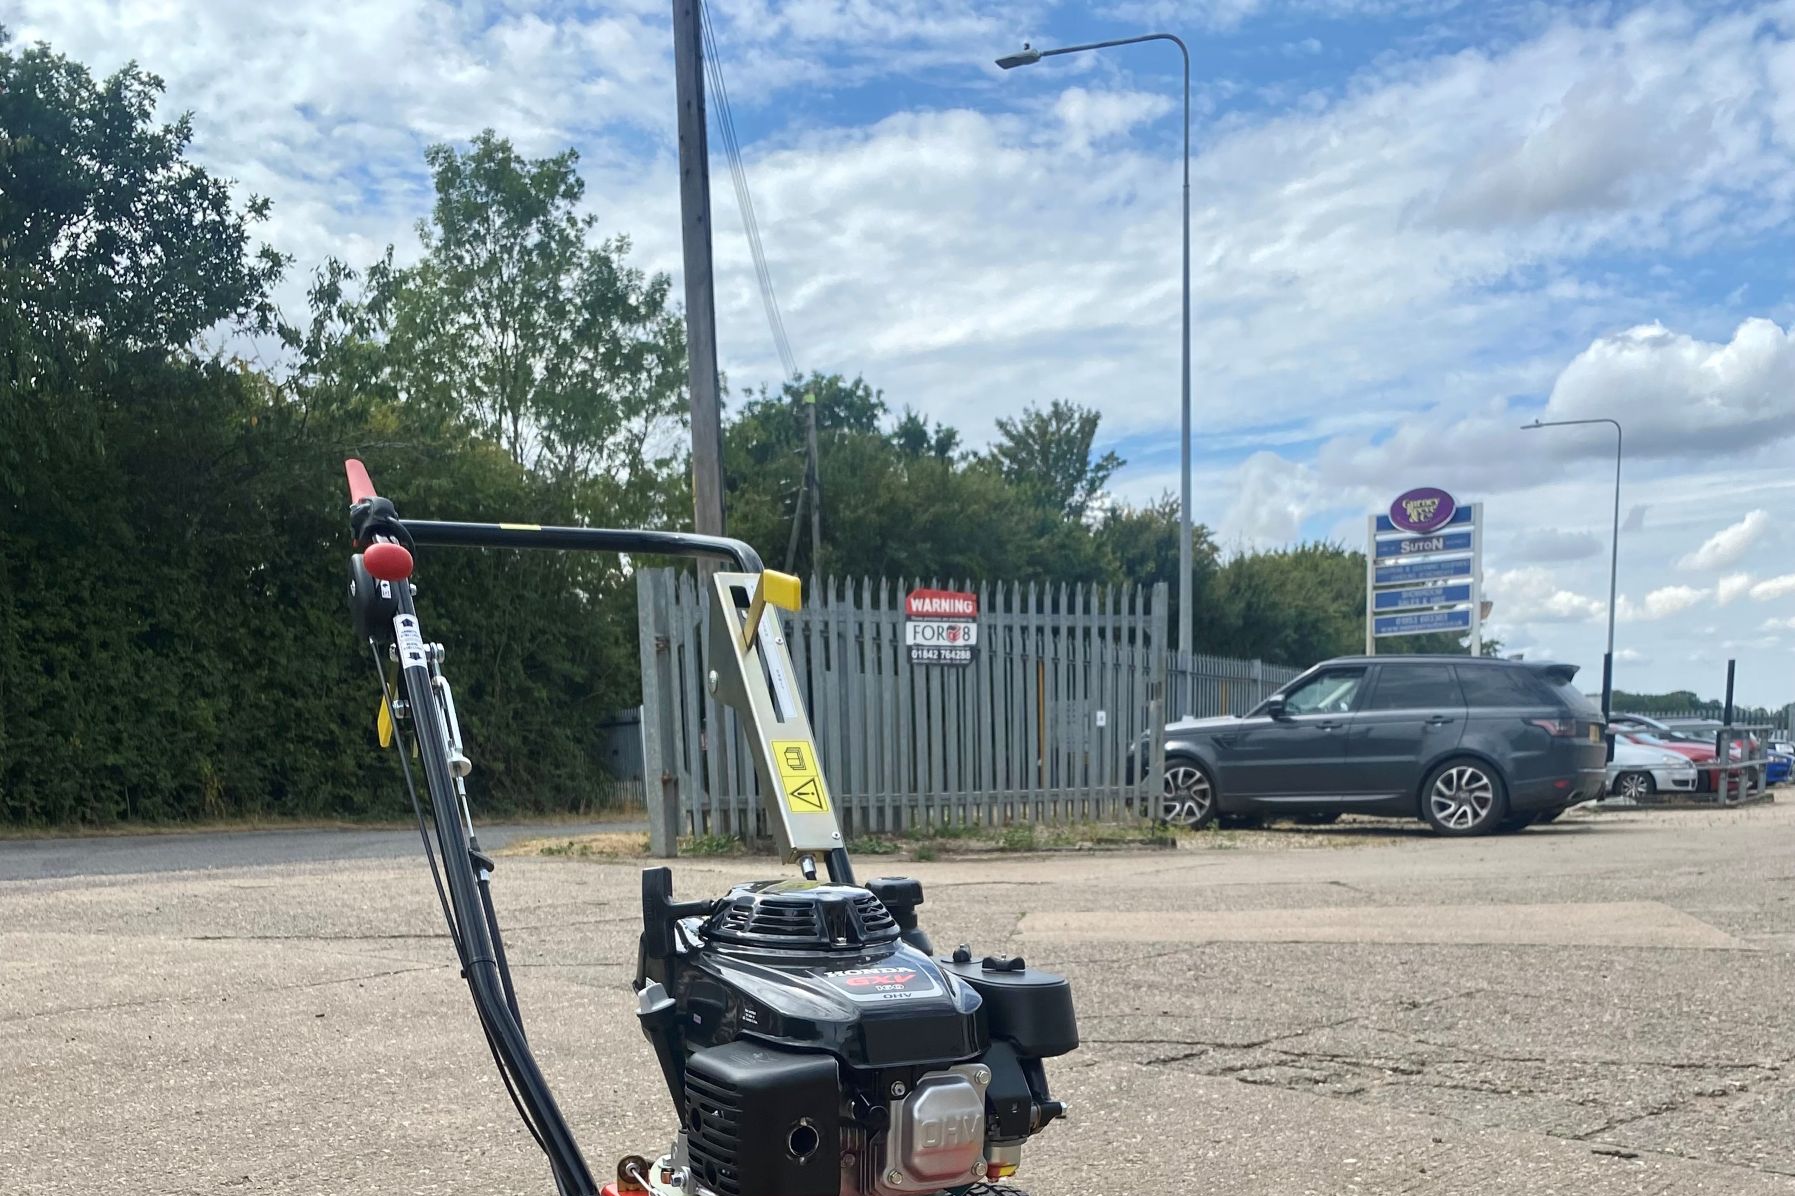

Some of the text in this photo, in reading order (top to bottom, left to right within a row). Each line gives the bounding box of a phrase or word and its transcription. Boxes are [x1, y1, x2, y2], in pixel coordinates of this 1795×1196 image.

[910, 597, 973, 613] WARNING
[824, 967, 916, 978] HONDA
[847, 973, 916, 986] GXV
[920, 1113, 982, 1149] OHV
